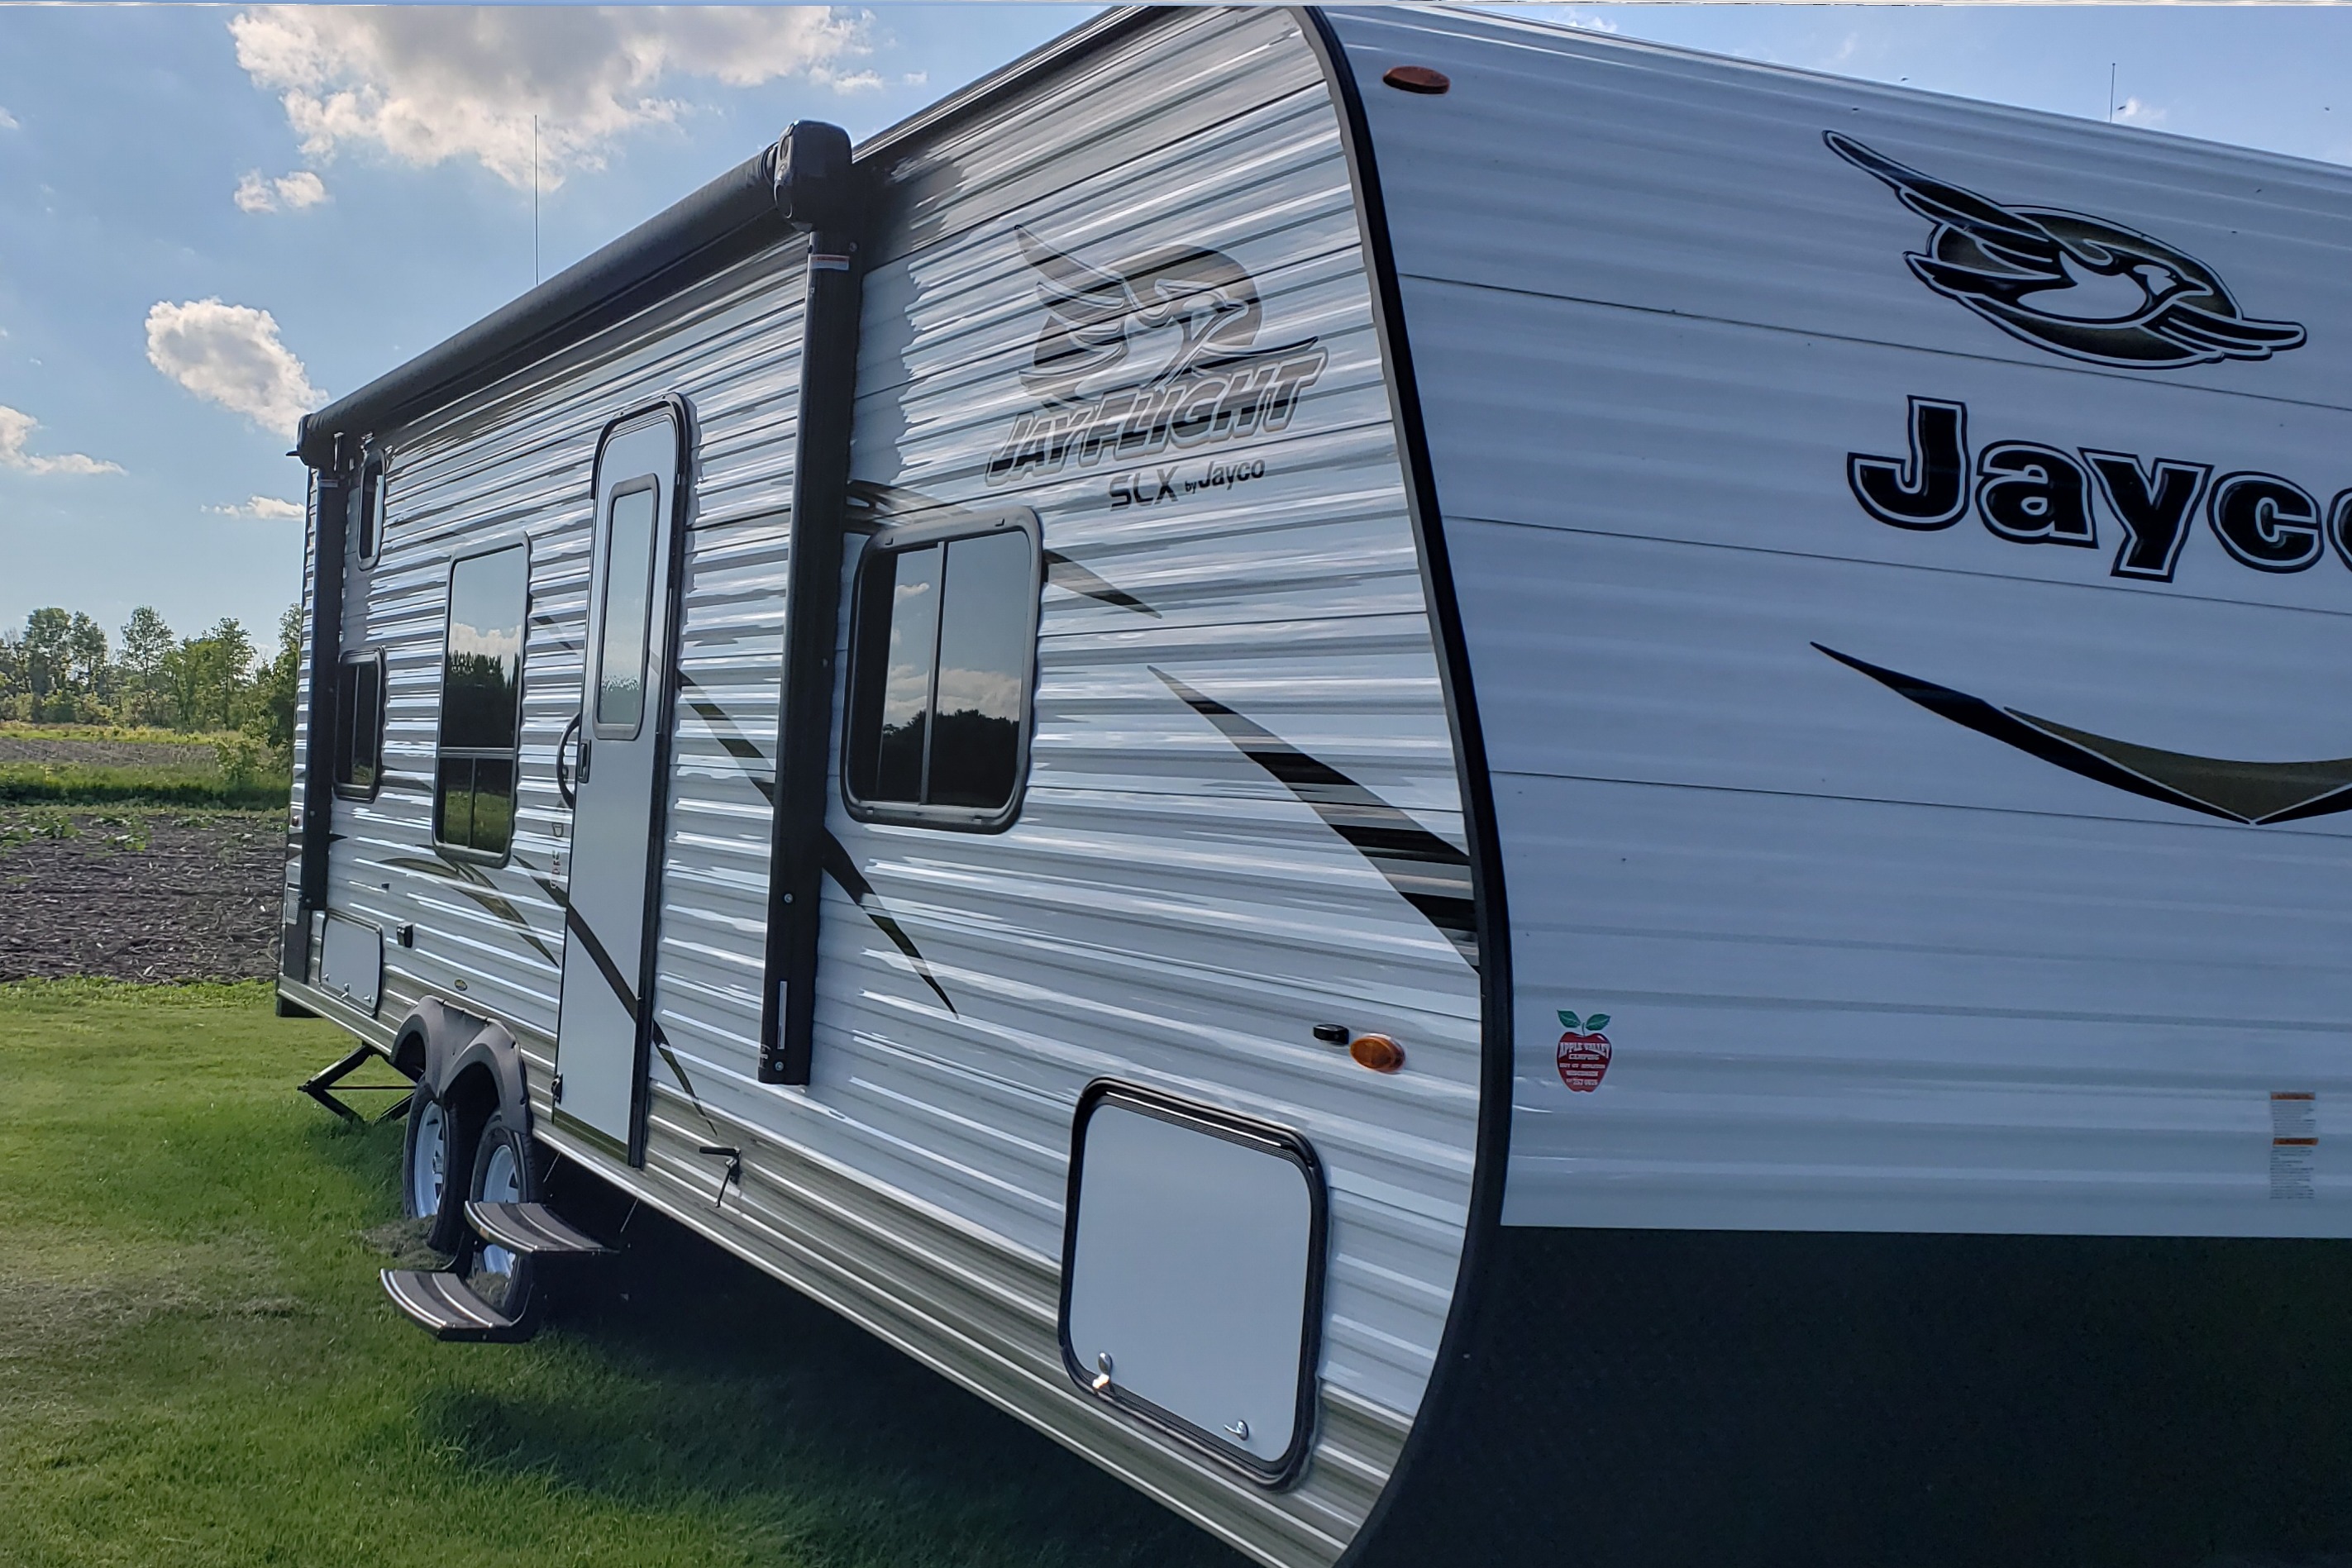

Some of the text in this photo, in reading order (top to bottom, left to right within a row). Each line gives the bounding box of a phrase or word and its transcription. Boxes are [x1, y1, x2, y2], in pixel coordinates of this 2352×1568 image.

[1109, 460, 1266, 512] SLX by Jayco
[1847, 395, 2352, 583] Jayc
[1559, 1042, 1610, 1059] APPLE VALLEY
